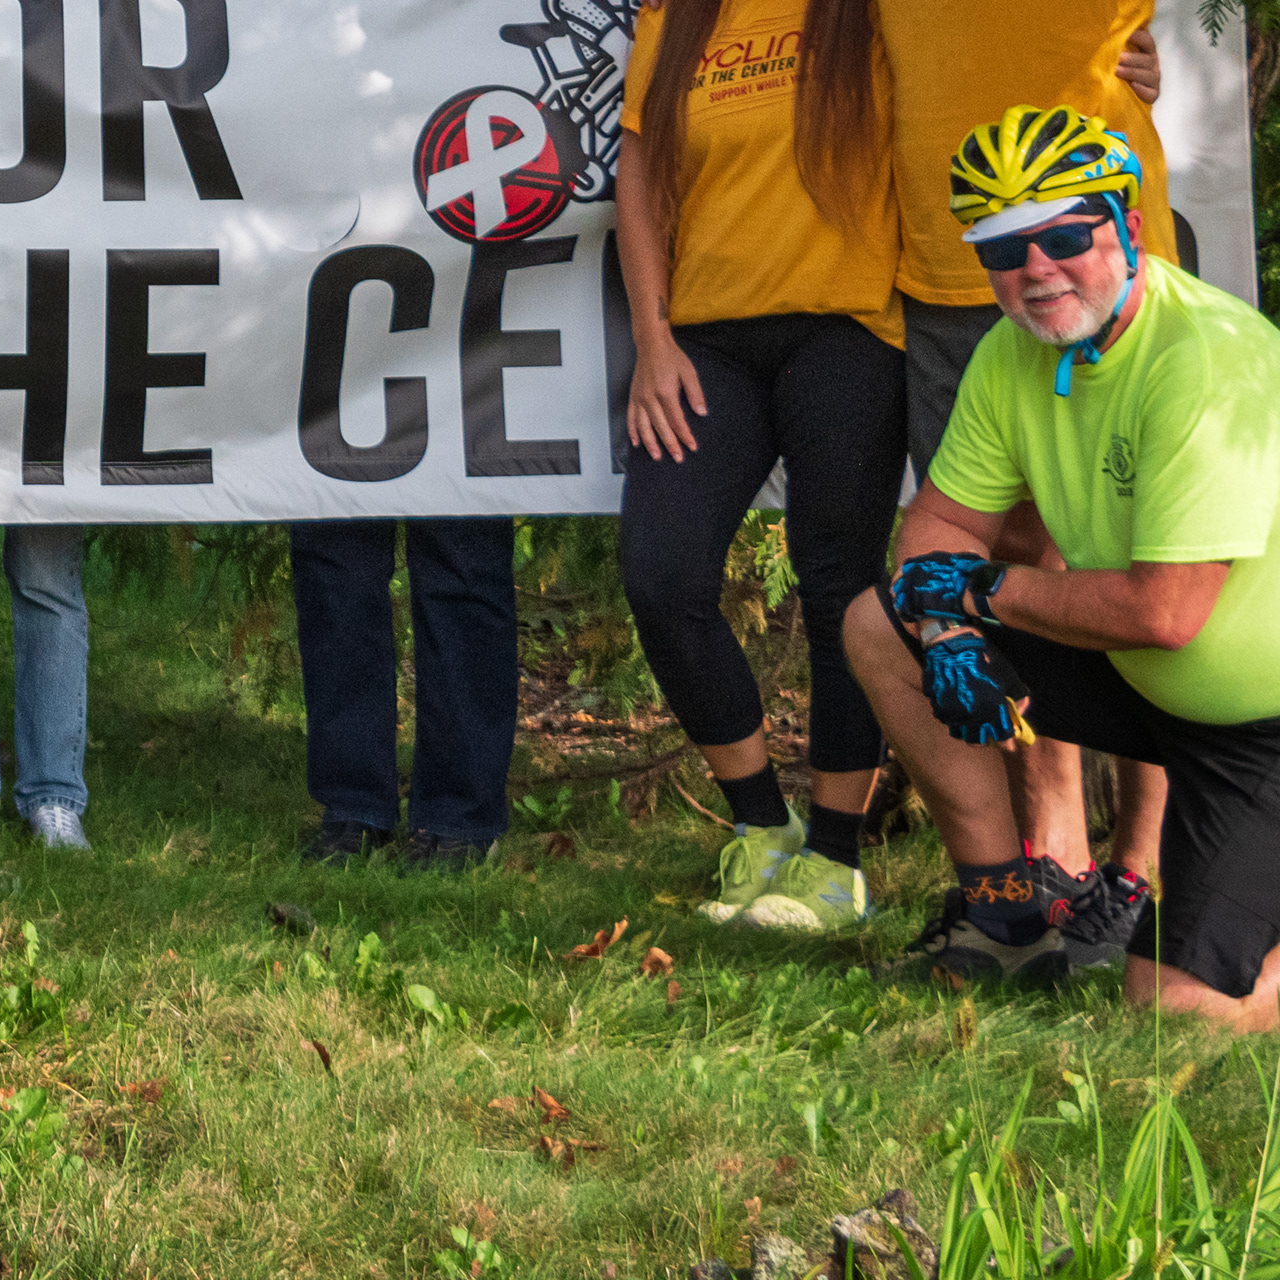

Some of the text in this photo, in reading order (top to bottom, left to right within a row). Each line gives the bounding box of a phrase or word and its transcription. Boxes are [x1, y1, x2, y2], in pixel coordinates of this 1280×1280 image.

[711, 67, 736, 85] THE
[740, 56, 796, 79] CENTER
[709, 83, 753, 103] SUPPORT
[756, 75, 787, 92] WHILE
